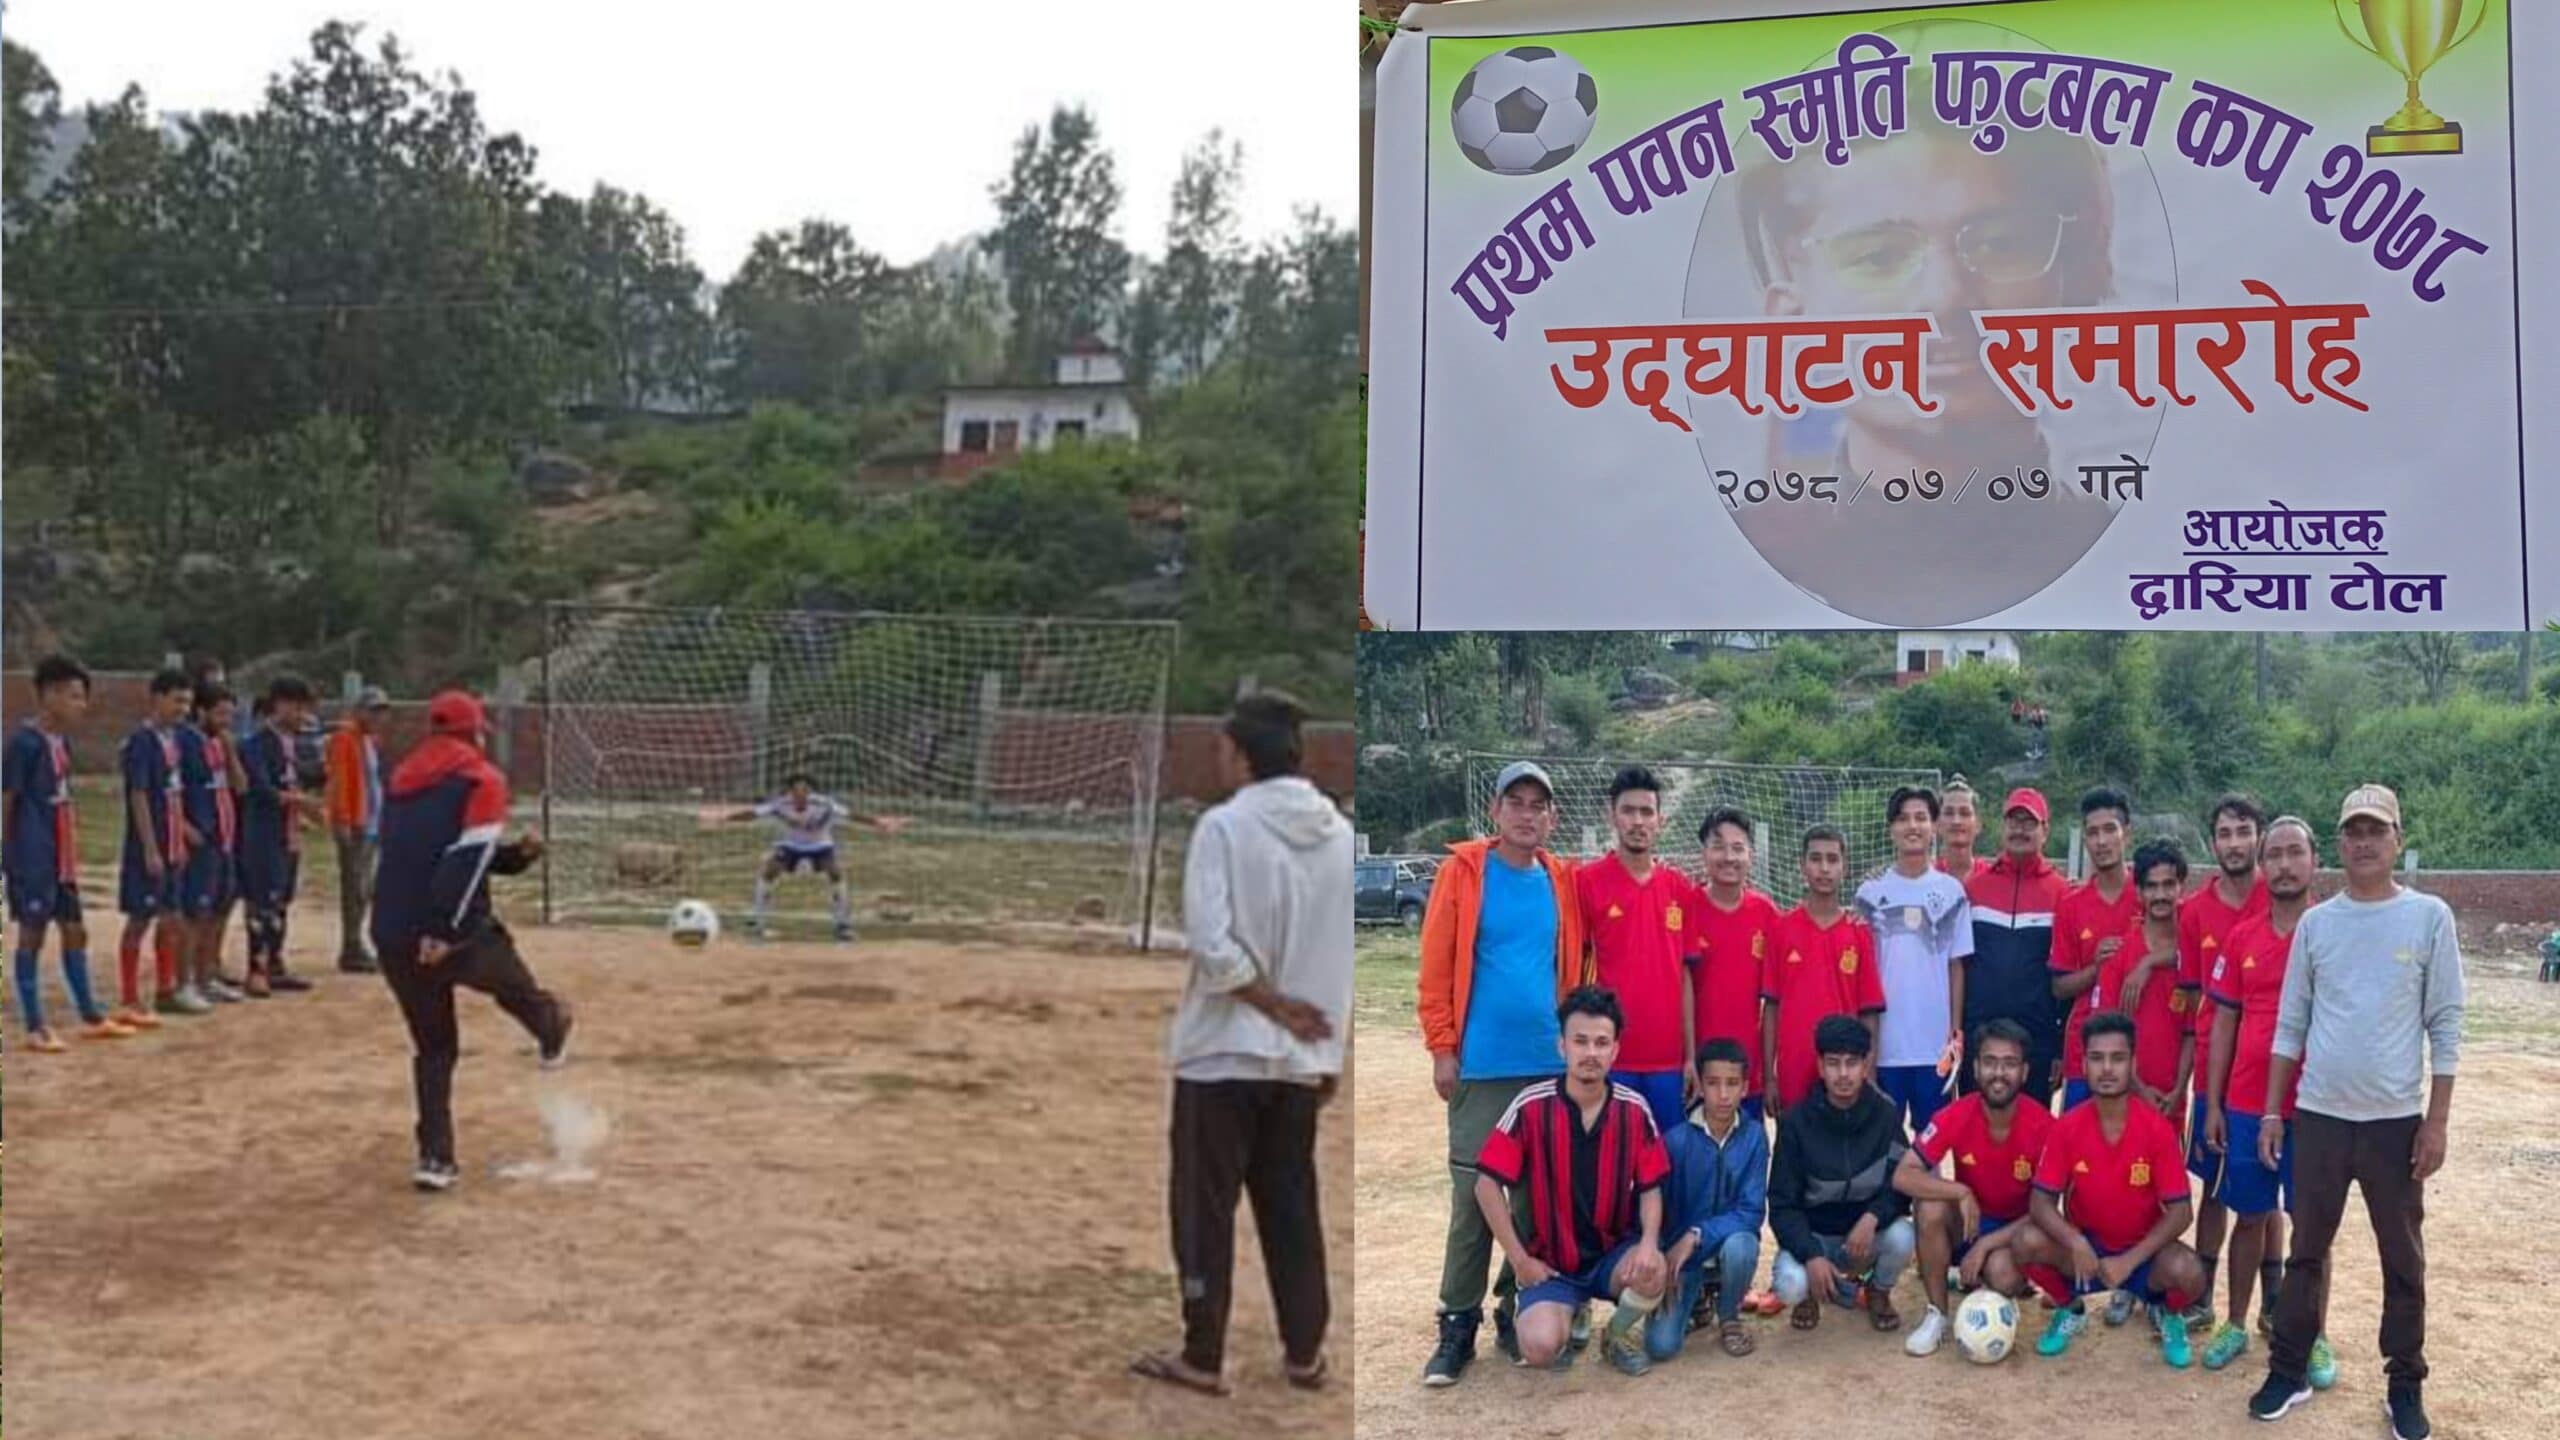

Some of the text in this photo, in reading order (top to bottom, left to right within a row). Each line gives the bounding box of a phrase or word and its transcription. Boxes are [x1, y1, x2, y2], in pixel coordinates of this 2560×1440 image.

[1451, 34, 2487, 340] प्रथम पवन स्मृति फुटबल कप २०७८
[1983, 280, 2369, 412] समारोह
[2077, 454, 2150, 502] गते
[2183, 499, 2388, 551] आयोजक
[2329, 561, 2448, 614] टोल
